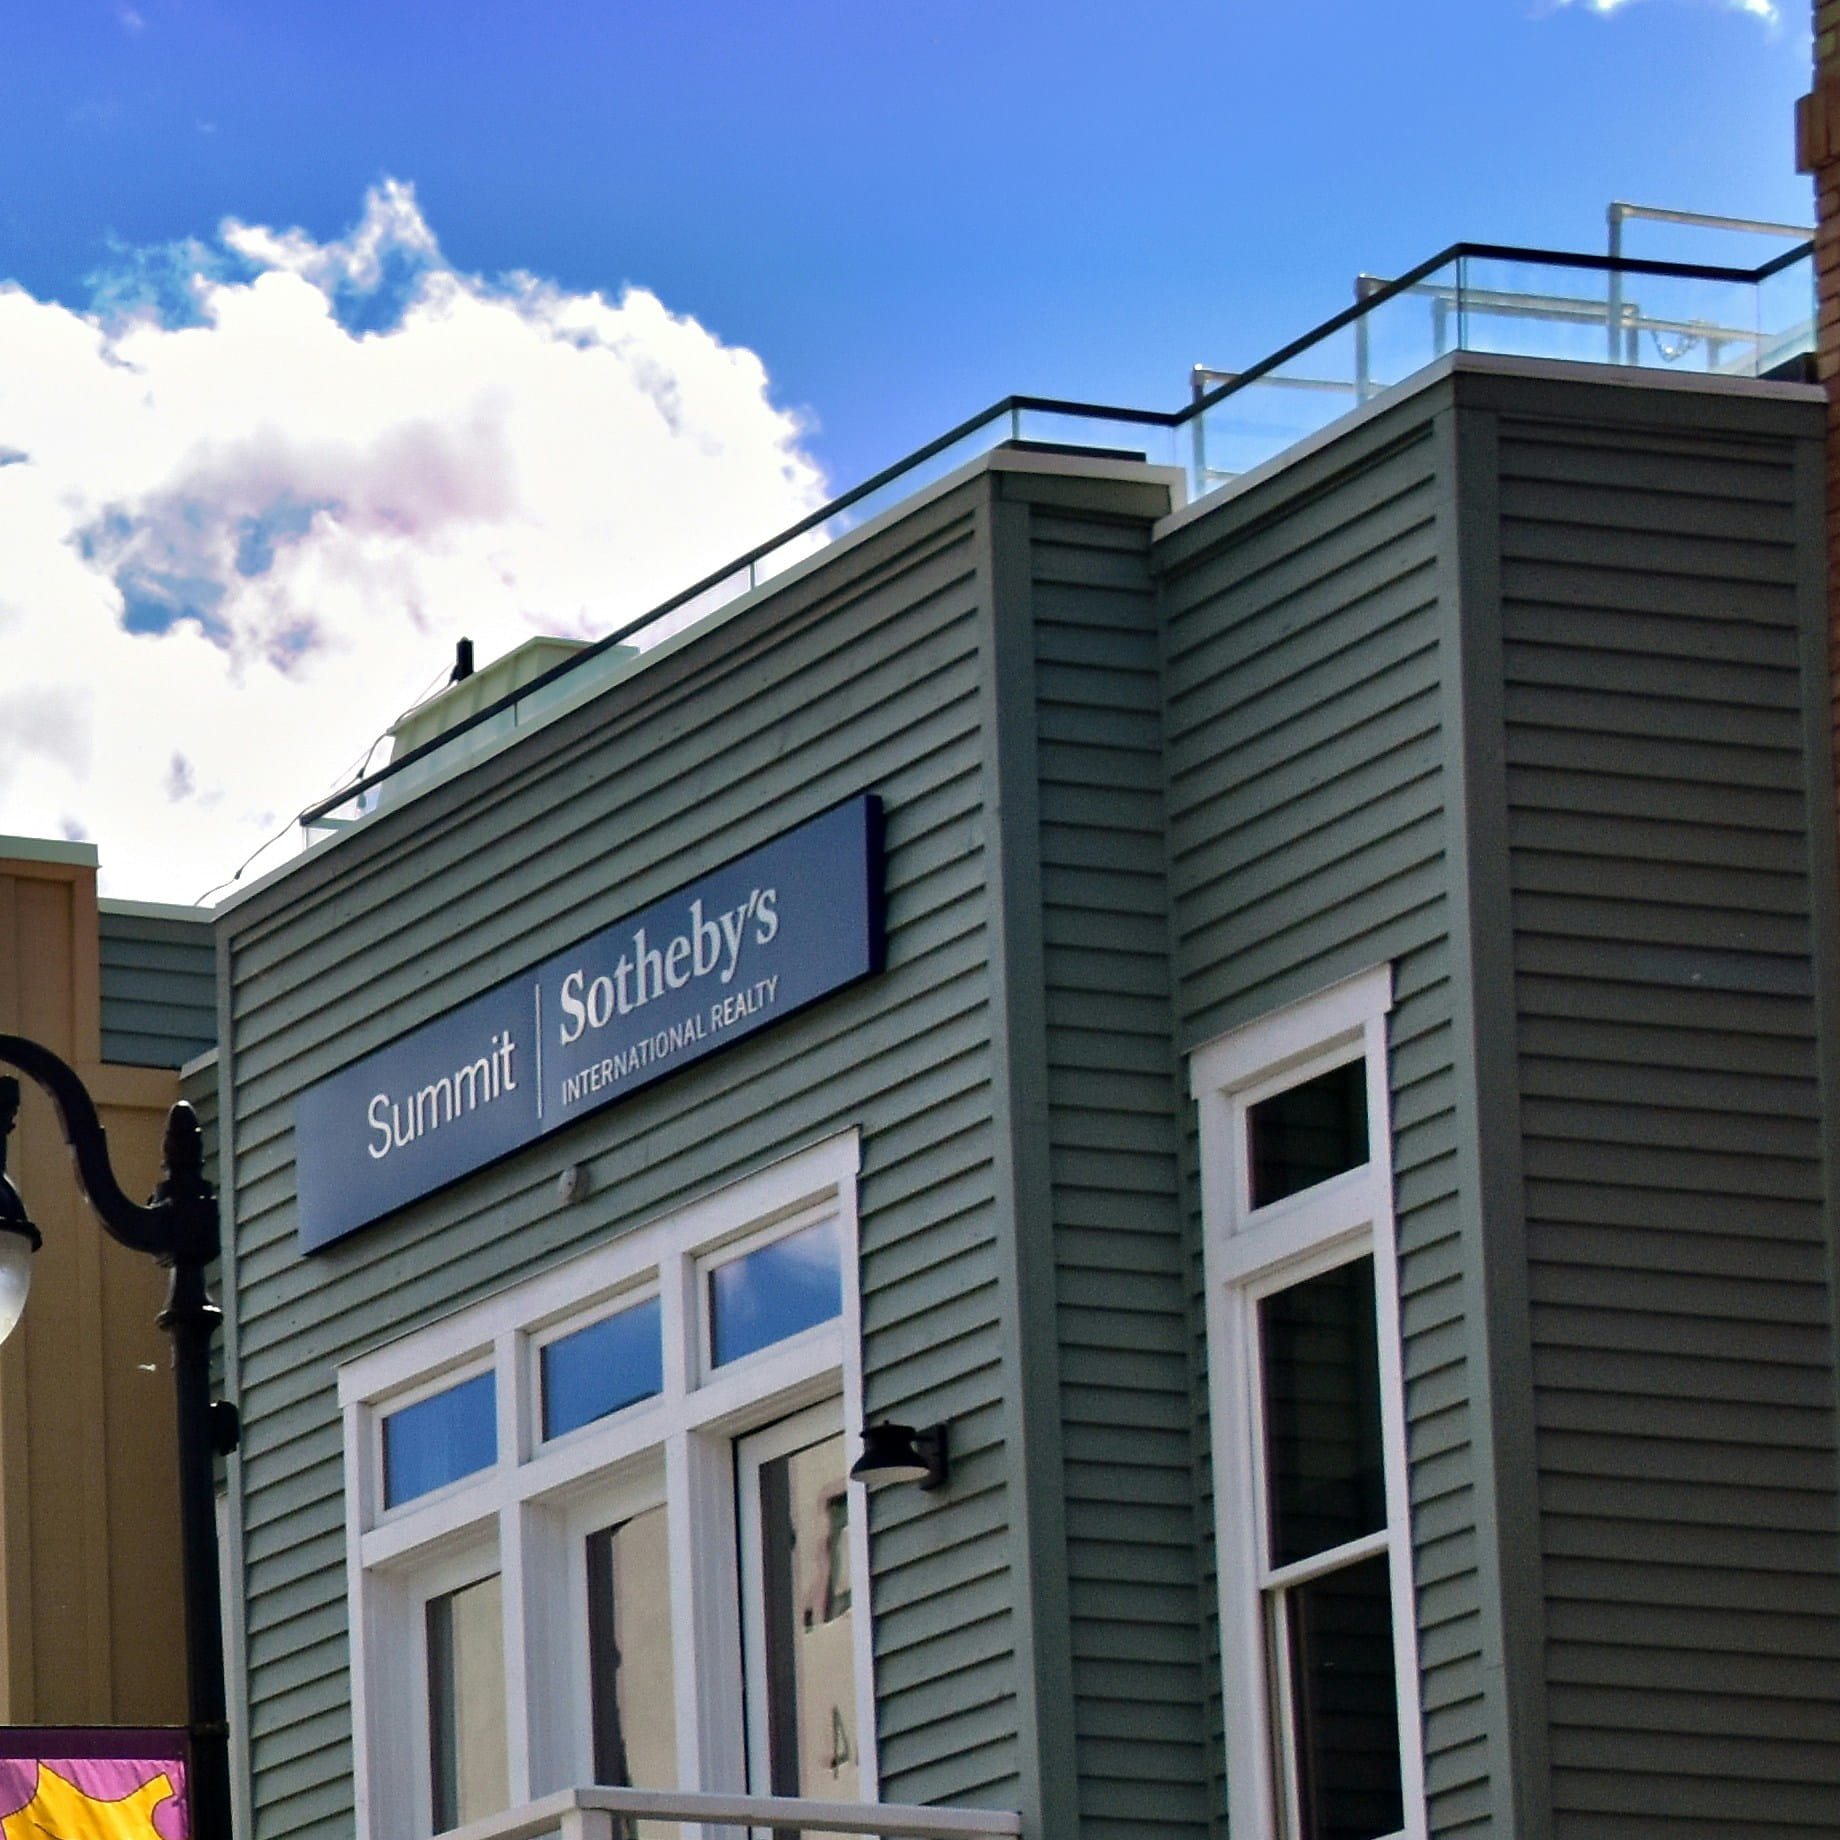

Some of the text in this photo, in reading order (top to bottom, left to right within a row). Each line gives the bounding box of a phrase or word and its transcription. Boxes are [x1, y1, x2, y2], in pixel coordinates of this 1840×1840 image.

[560, 886, 779, 1045] Sotheby's
[367, 1029, 517, 1159] Summit
[561, 974, 779, 1105] INTERNATIONAL REALTY
